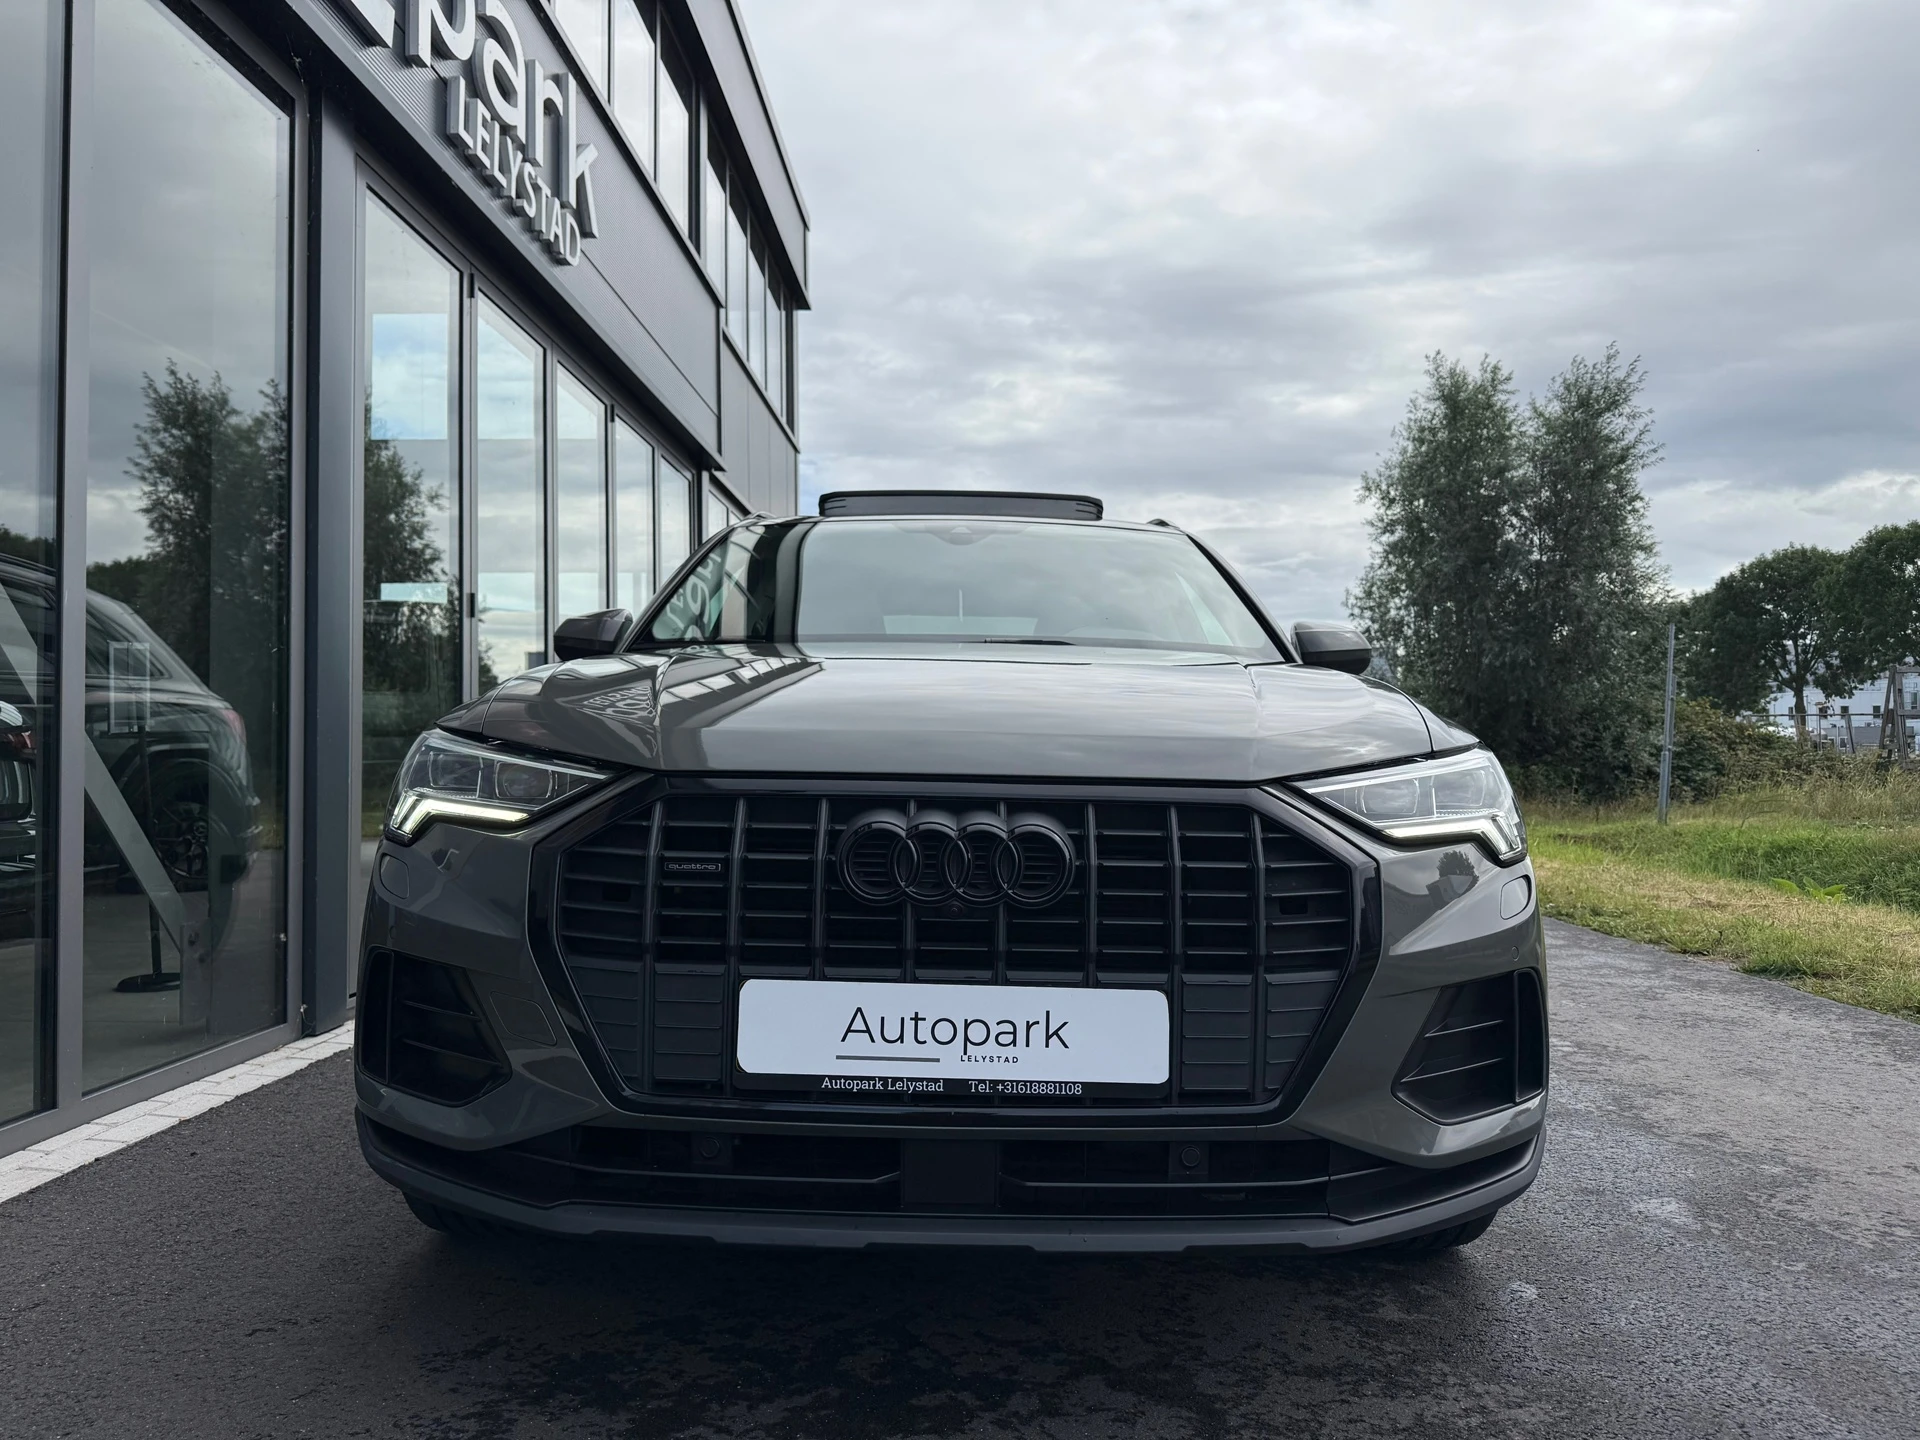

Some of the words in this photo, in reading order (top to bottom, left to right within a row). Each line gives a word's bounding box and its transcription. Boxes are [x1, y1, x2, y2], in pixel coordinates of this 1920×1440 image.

[446, 75, 582, 267] LELYSTAD
[840, 1006, 1070, 1055] Autopark
[960, 1055, 1019, 1064] LELYSTAD
[821, 1077, 884, 1092] Autopark
[887, 1079, 944, 1094] Lelystad
[969, 1081, 993, 1093] Tel:
[996, 1081, 1082, 1095] +31618881108
